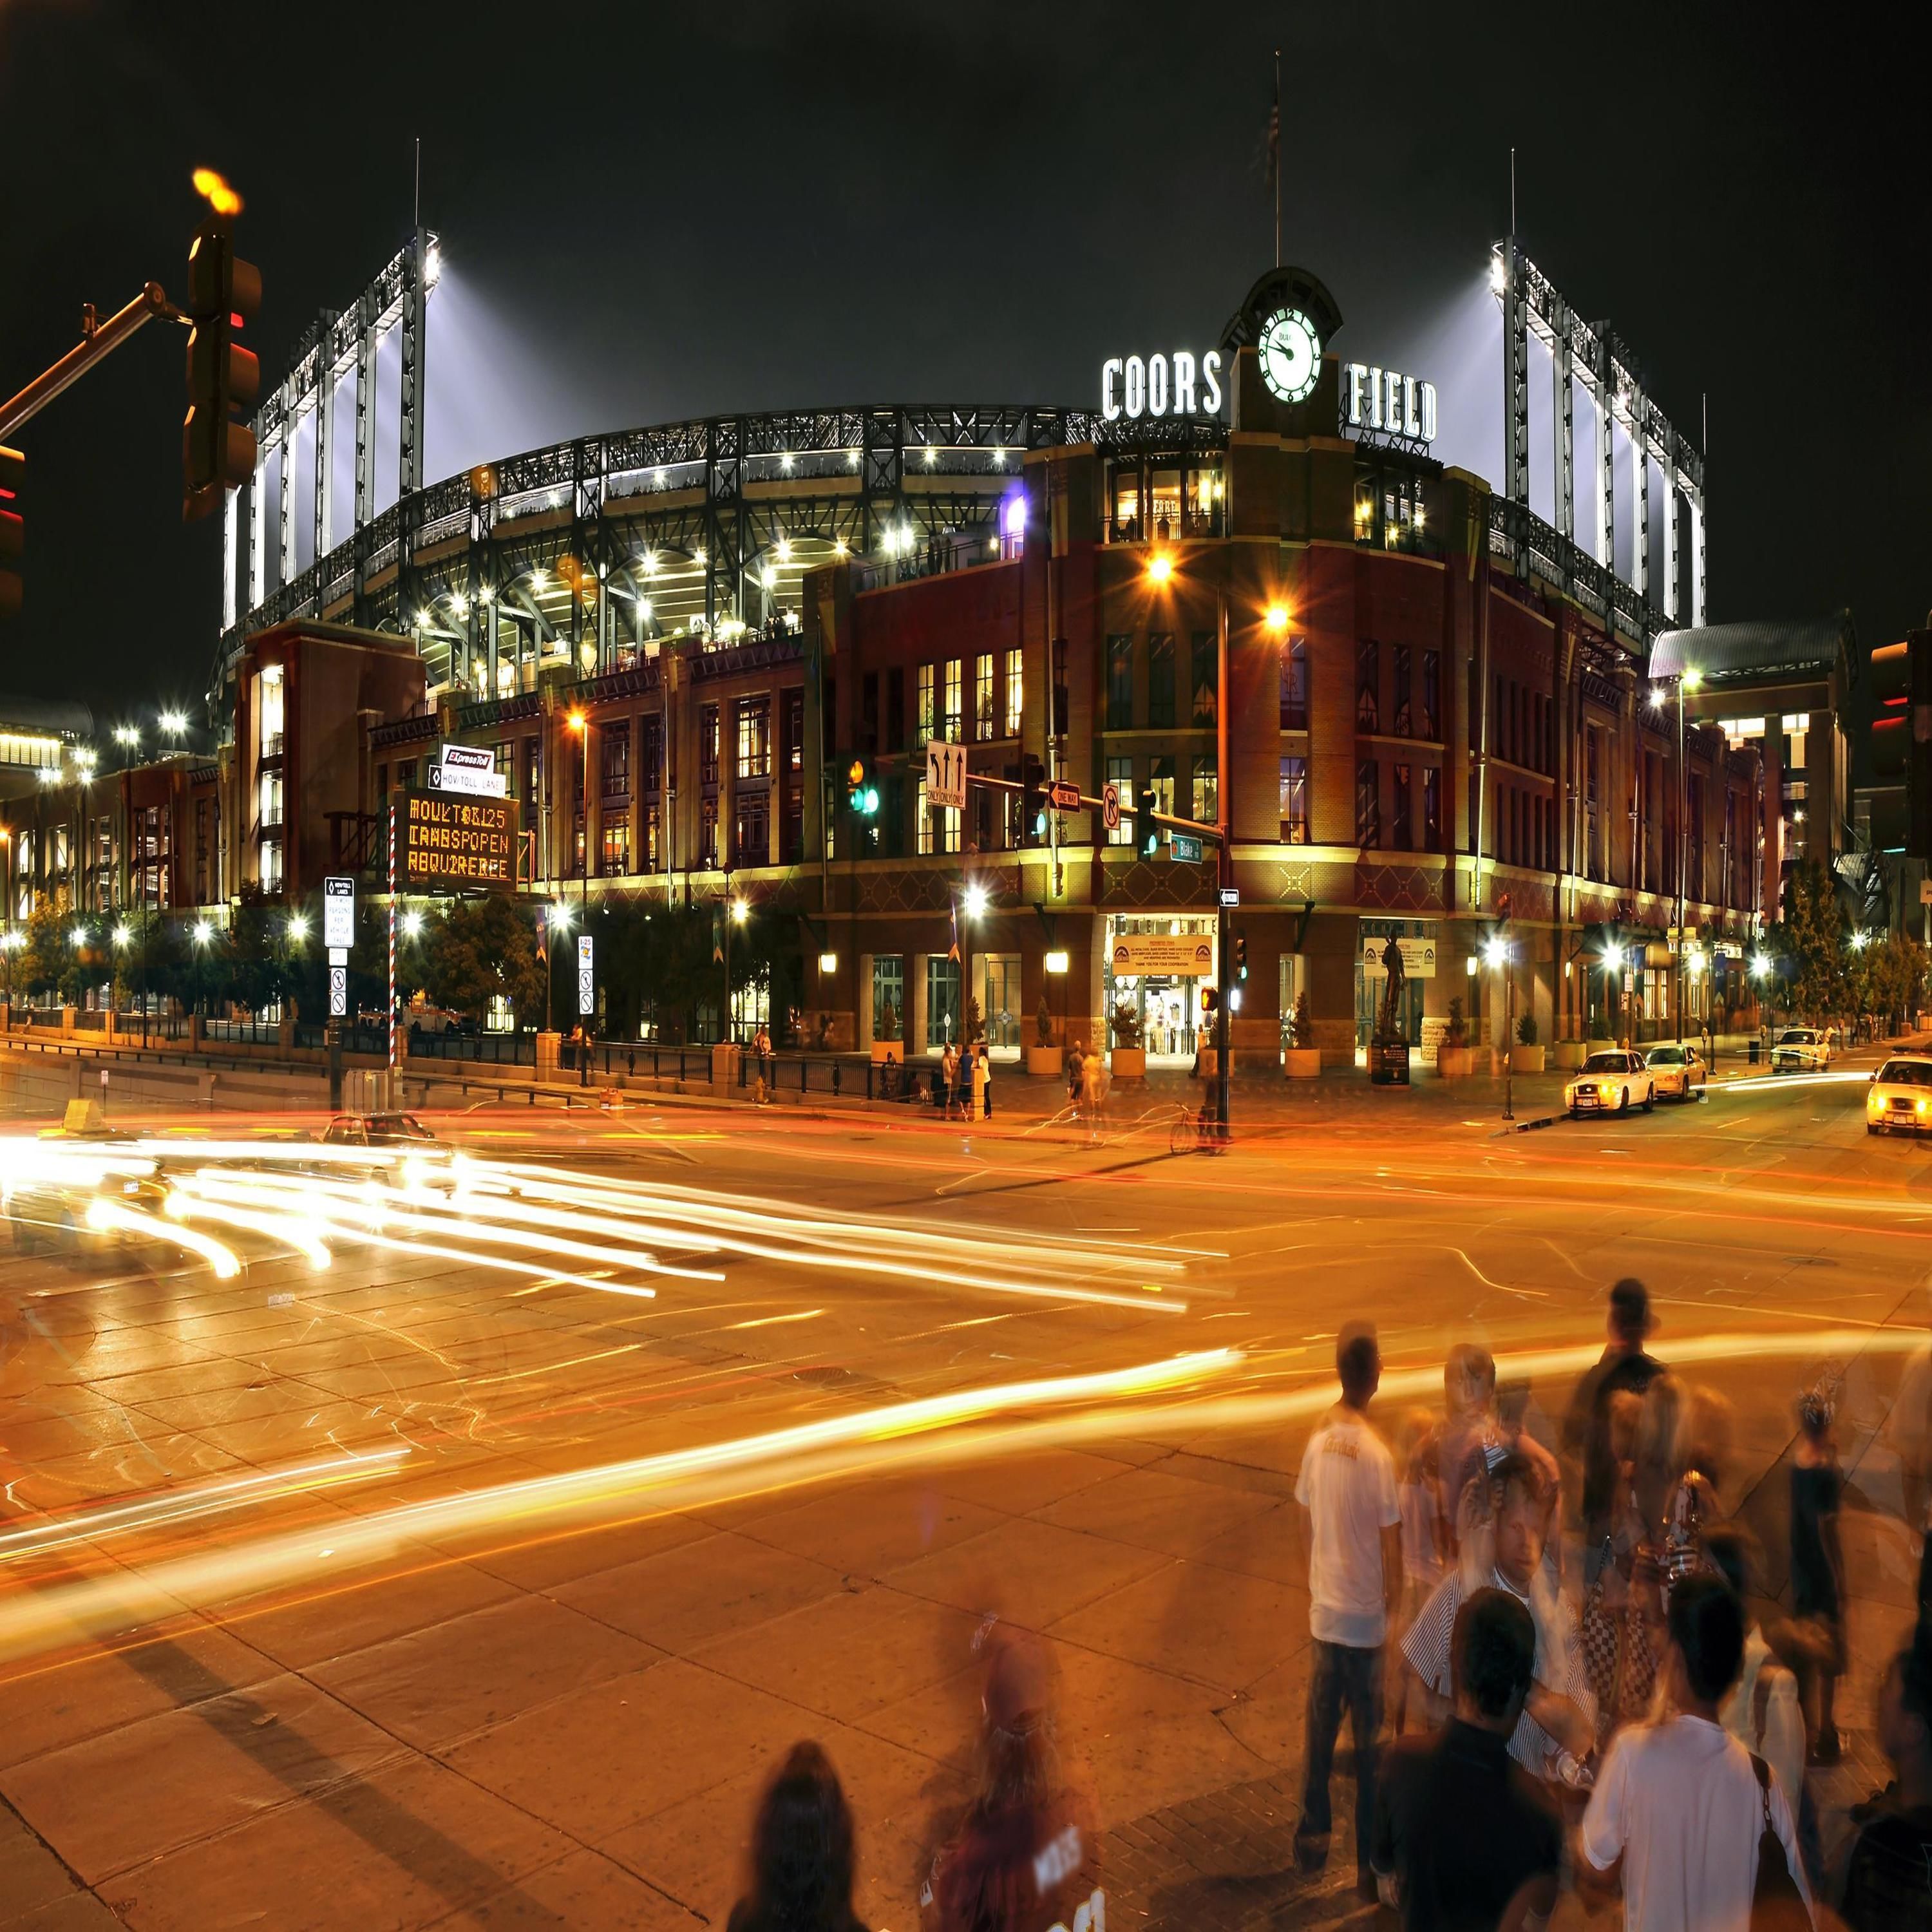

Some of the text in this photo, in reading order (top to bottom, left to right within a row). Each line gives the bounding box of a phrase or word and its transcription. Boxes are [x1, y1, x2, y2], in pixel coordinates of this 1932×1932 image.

[1284, 308, 1294, 320] 12
[1103, 351, 1437, 442] COORS FIELD
[1288, 392, 1294, 402] 6
[443, 774, 504, 791] HOV/TOLL LANES
[928, 790, 964, 804] ONLY ONLY ONLY
[1058, 791, 1076, 804] ONE WAY
[1180, 840, 1193, 857] Blake
